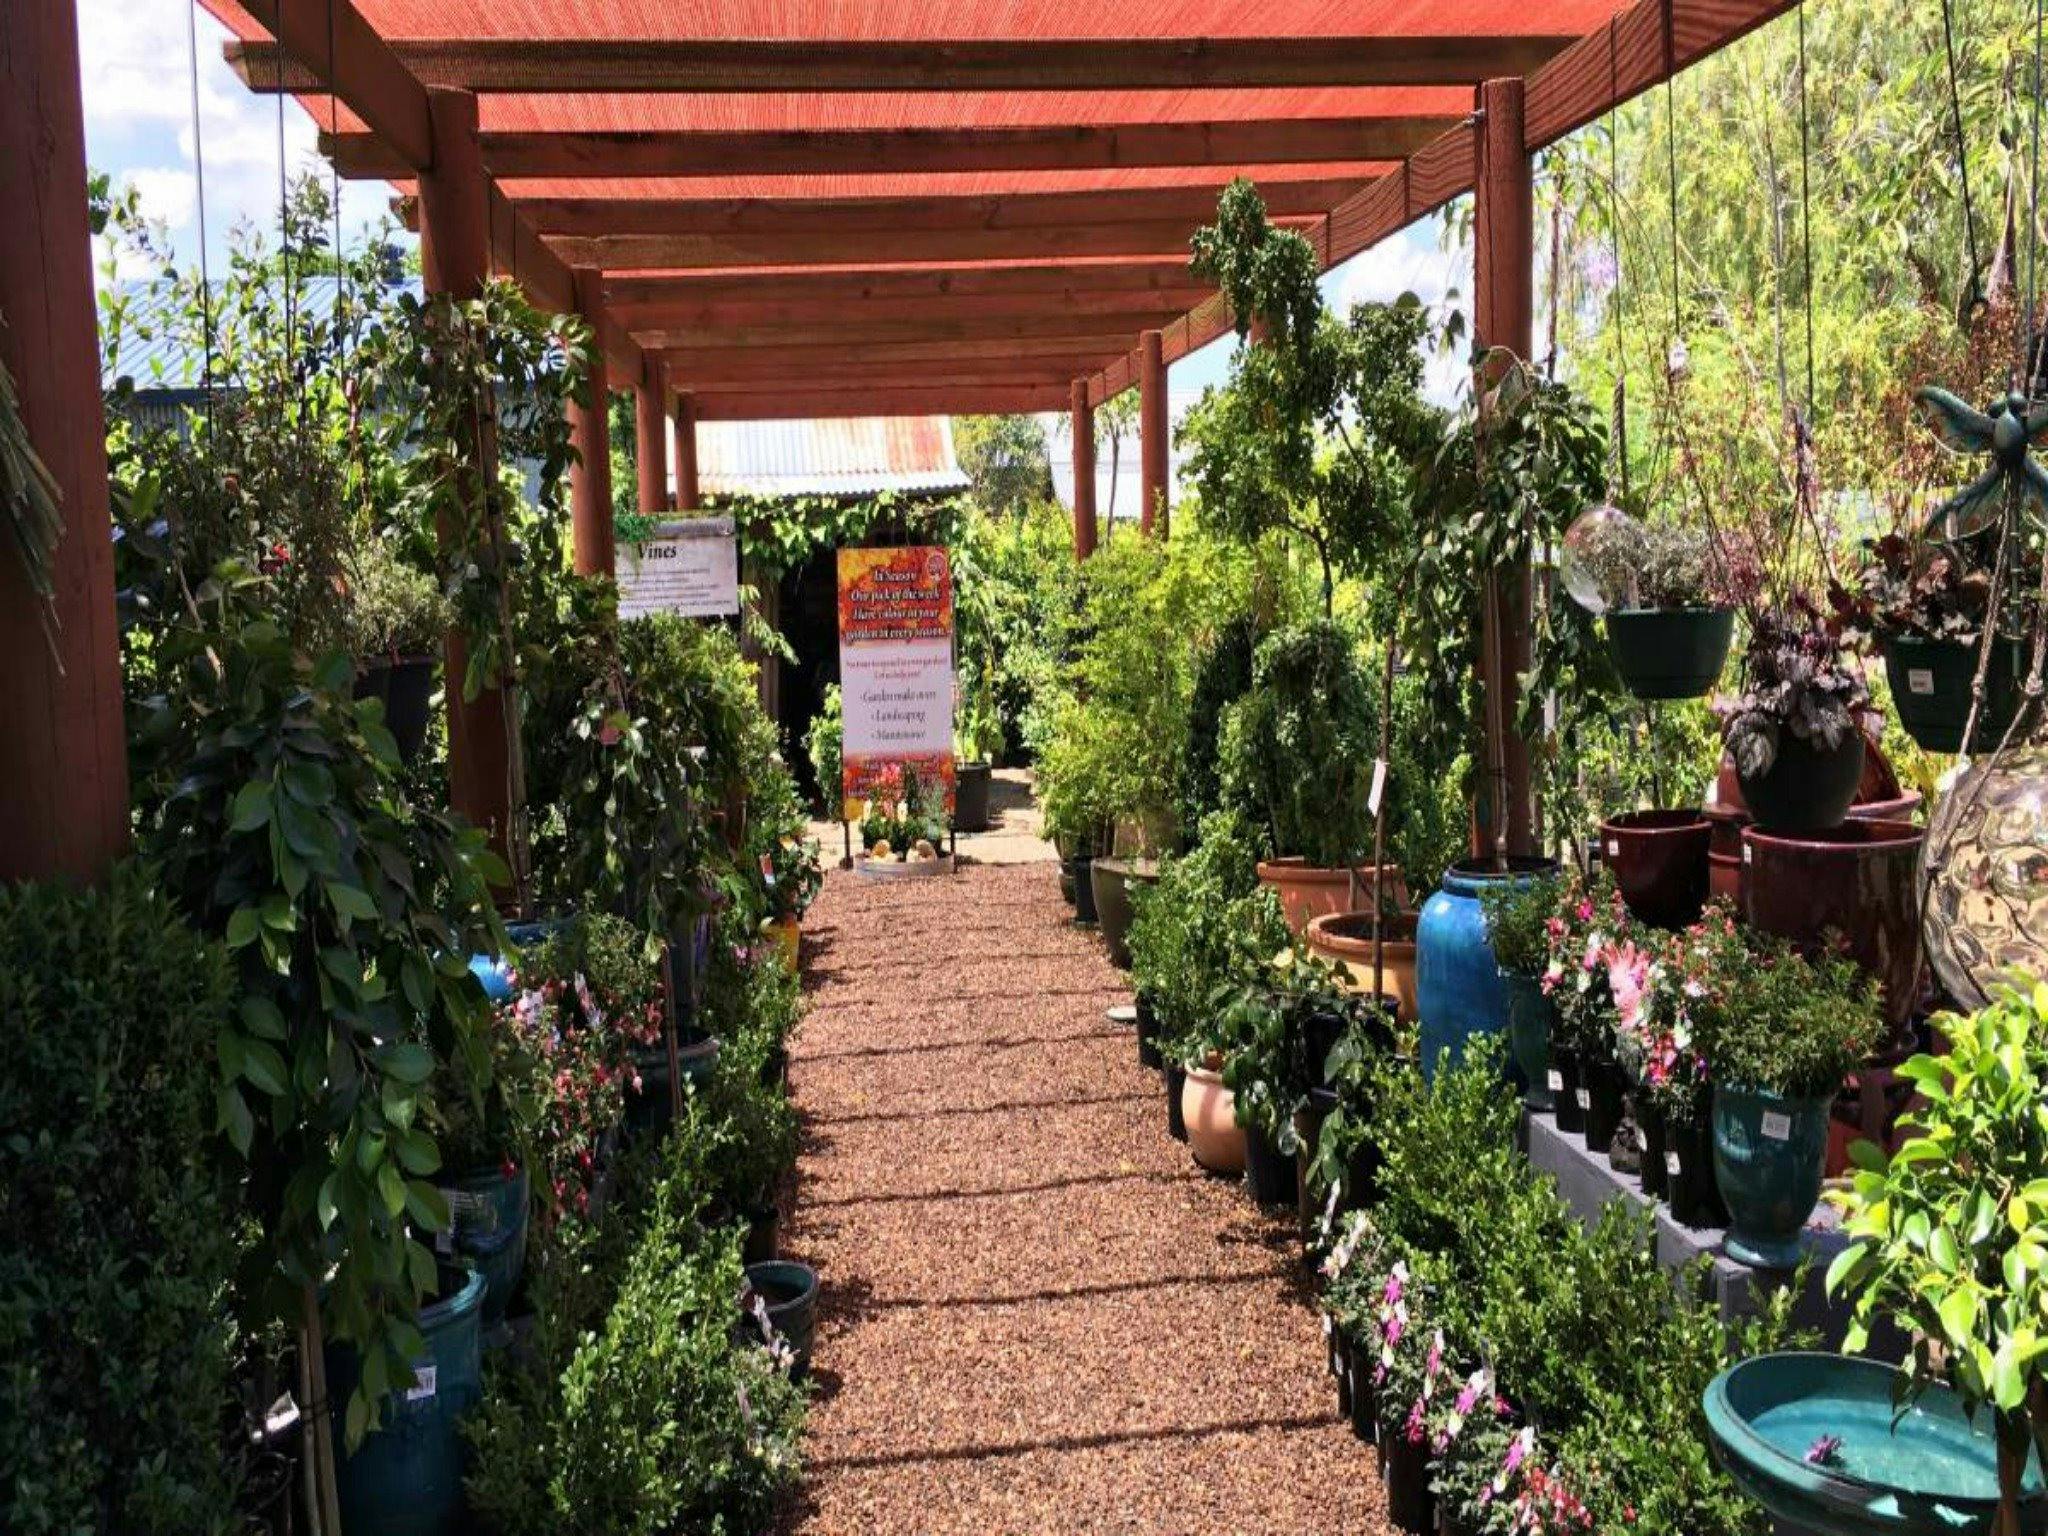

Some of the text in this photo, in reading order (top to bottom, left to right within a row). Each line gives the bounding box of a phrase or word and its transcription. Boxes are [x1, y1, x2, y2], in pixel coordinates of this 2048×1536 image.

[638, 543, 677, 559] Vines
[871, 588, 891, 603] pick
[876, 709, 926, 724] Landscaping
